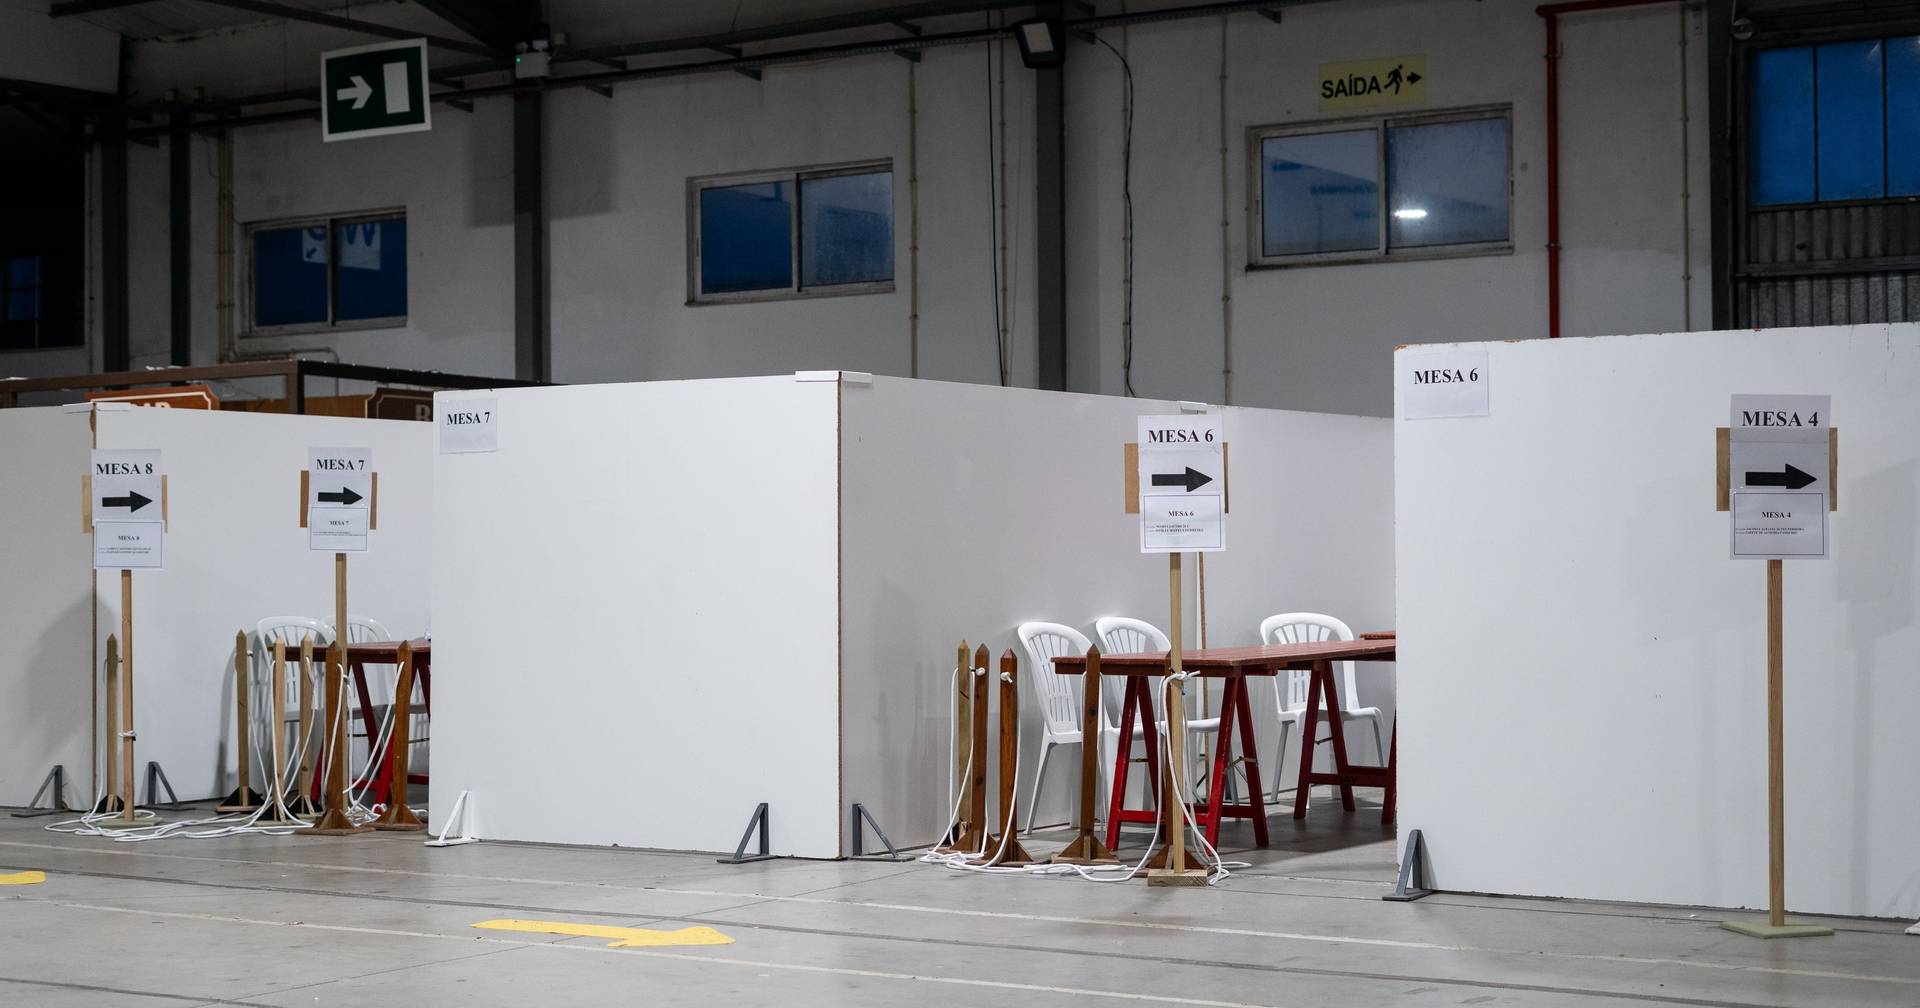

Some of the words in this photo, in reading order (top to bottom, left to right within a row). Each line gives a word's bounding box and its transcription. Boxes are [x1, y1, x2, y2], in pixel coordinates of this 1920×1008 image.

[1321, 74, 1382, 99] SAÍDA
[1415, 369, 1465, 385] MESA
[1469, 367, 1479, 383] 6
[447, 412, 481, 425] MESA
[484, 411, 491, 424] 7
[1742, 410, 1802, 427] MESA
[1808, 411, 1819, 427] 4
[1148, 429, 1200, 443] MESA
[1204, 428, 1214, 443] 6
[96, 463, 141, 475] MESA
[145, 463, 153, 475] 8
[316, 458, 355, 471] MESA
[358, 459, 365, 471] 7
[1761, 511, 1785, 519] MESA
